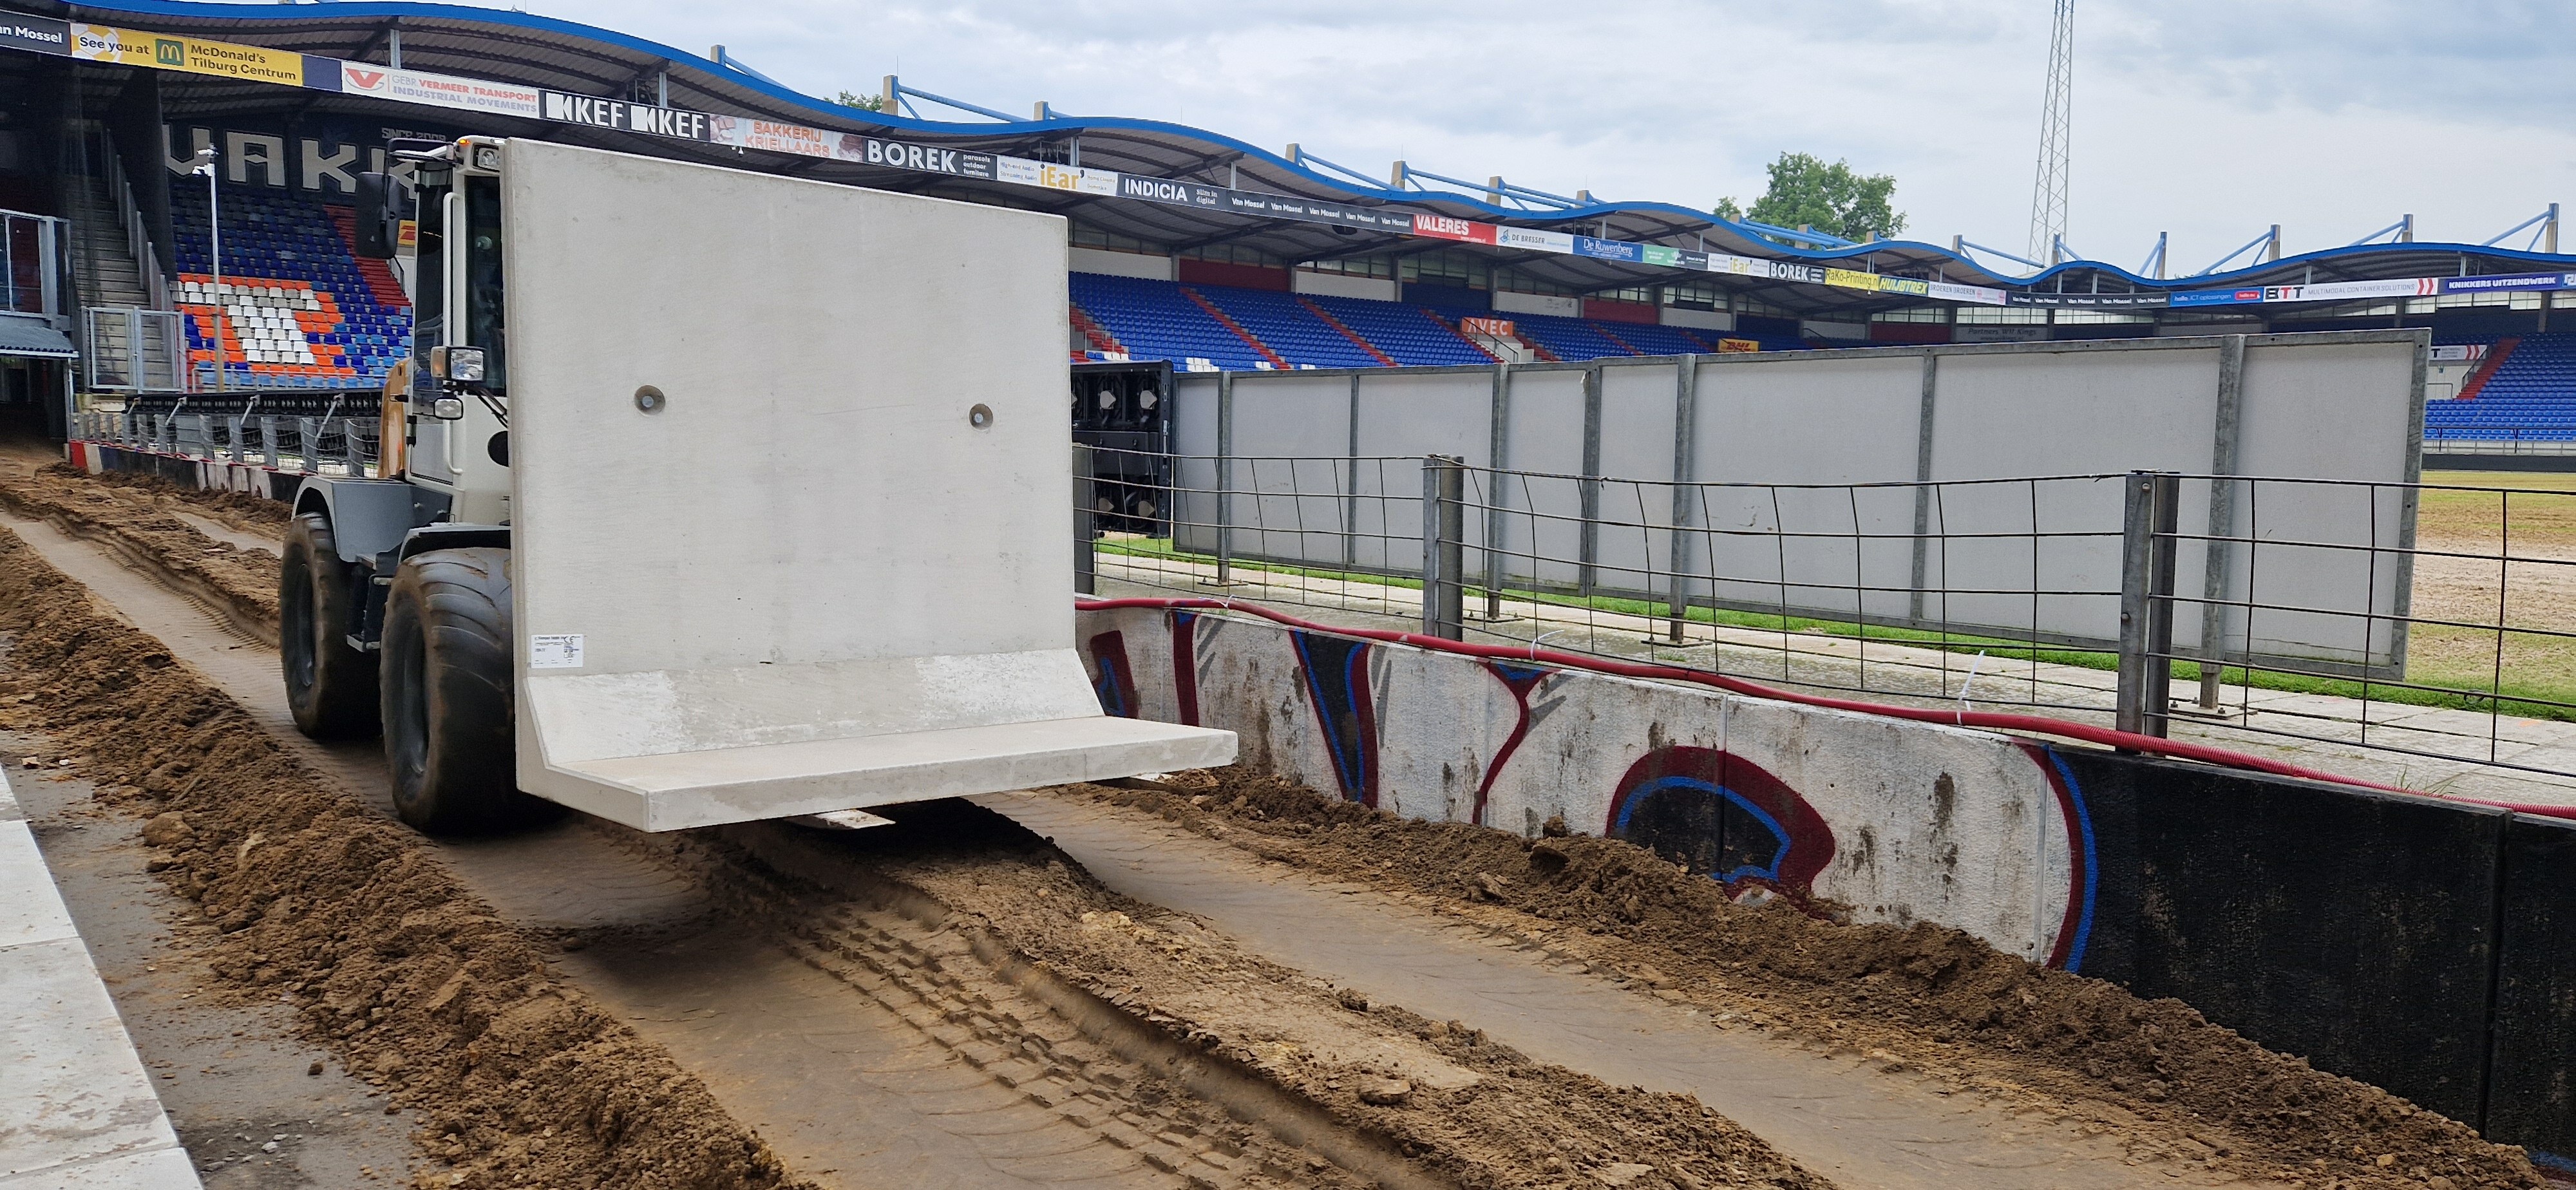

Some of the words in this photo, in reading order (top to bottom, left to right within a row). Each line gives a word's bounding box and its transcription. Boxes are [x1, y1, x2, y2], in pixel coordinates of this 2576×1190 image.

[15, 26, 62, 43] Mossel
[80, 37, 104, 49] See
[108, 42, 133, 52] you
[136, 45, 149, 55] at
[191, 44, 266, 63] McDonald's
[191, 57, 238, 74] Tilburg
[241, 64, 296, 80] Centrum
[419, 79, 469, 93] VERMEER
[473, 86, 537, 102] TRANSPORT
[392, 86, 463, 102] INDUSTRIAL
[467, 97, 537, 113] MOVEMENTS
[575, 97, 624, 128] KEF
[658, 109, 704, 140] KEF
[753, 120, 822, 143] BAKKERIJ
[744, 135, 830, 157] KRIELLAARS
[867, 139, 957, 173] BOREK
[963, 154, 990, 163] parasols
[963, 161, 986, 169] outdoor
[963, 167, 989, 178] furniture
[1125, 178, 1188, 202] INDICIA
[1196, 196, 1216, 205] digital
[1231, 197, 1243, 205] Van
[1244, 199, 1265, 209] Mossel
[1271, 202, 1282, 211] Van
[1283, 204, 1302, 214] Mossel
[1309, 207, 1320, 215] Van
[1320, 209, 1340, 218] Mossel
[1345, 212, 1356, 220] Van
[1357, 214, 1376, 223] Mossel
[1392, 218, 1410, 227] Mossel
[1416, 214, 1469, 236] VALERES
[1520, 234, 1545, 244] BRESSER
[1584, 238, 1595, 249] De
[1595, 240, 1633, 258] Ruwenberg
[1770, 262, 1809, 281] BOREK
[2448, 280, 2492, 289] KNIKKERS
[2492, 277, 2556, 287] UITZENDWERK
[2265, 286, 2304, 300] BTT
[1468, 319, 1508, 335] AVEC
[1726, 341, 1751, 352] DHL
